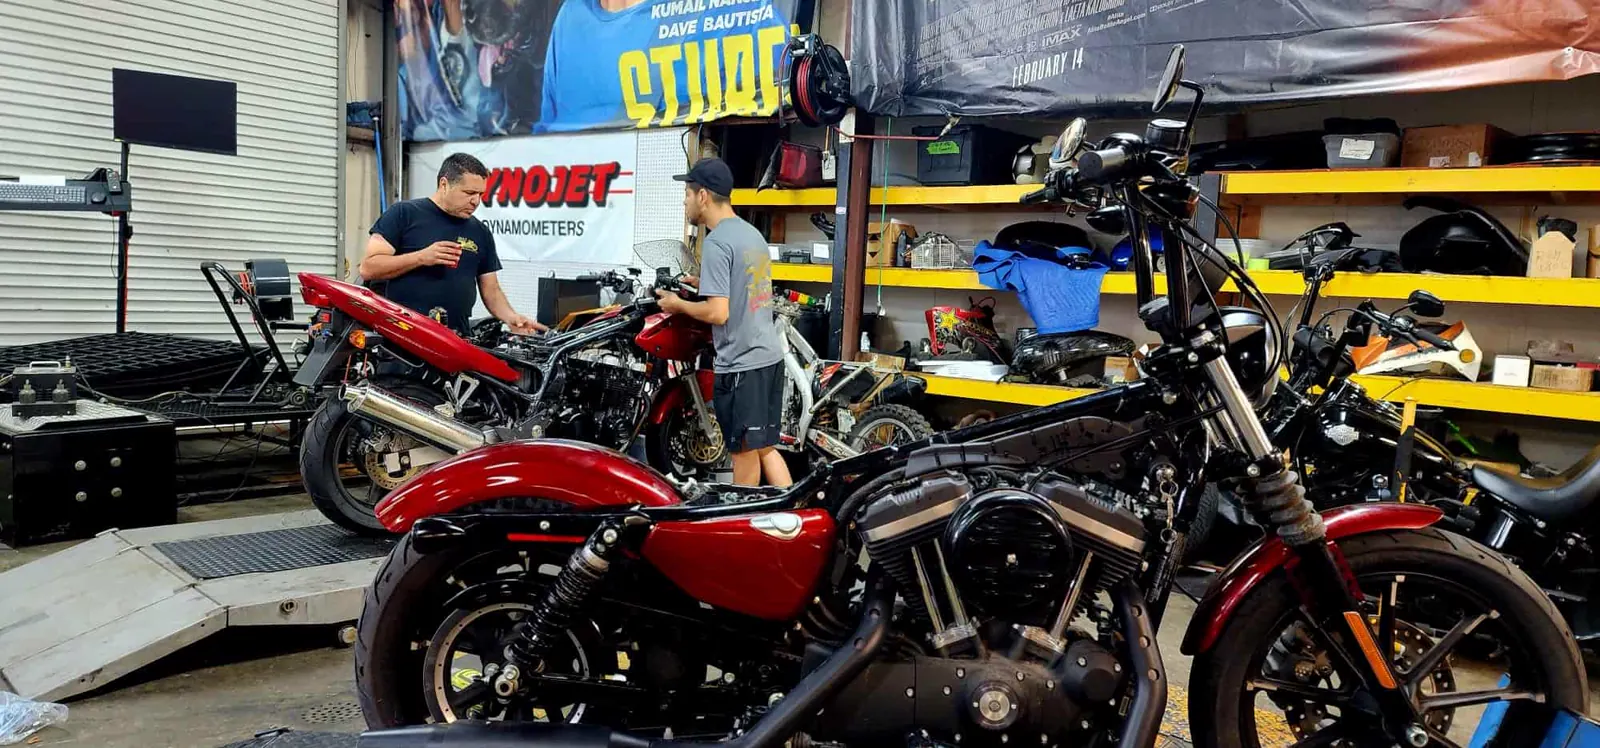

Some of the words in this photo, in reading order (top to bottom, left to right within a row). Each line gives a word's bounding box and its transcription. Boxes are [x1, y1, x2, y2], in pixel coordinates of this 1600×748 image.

[651, 0, 706, 19] KUMAIL
[658, 19, 699, 39] DAVE
[702, 5, 774, 32] BAUTISTA
[1041, 27, 1082, 47] IMAX
[1012, 51, 1068, 88] FEBRUARY
[1072, 47, 1084, 71] 14
[480, 161, 621, 208] YNOJET
